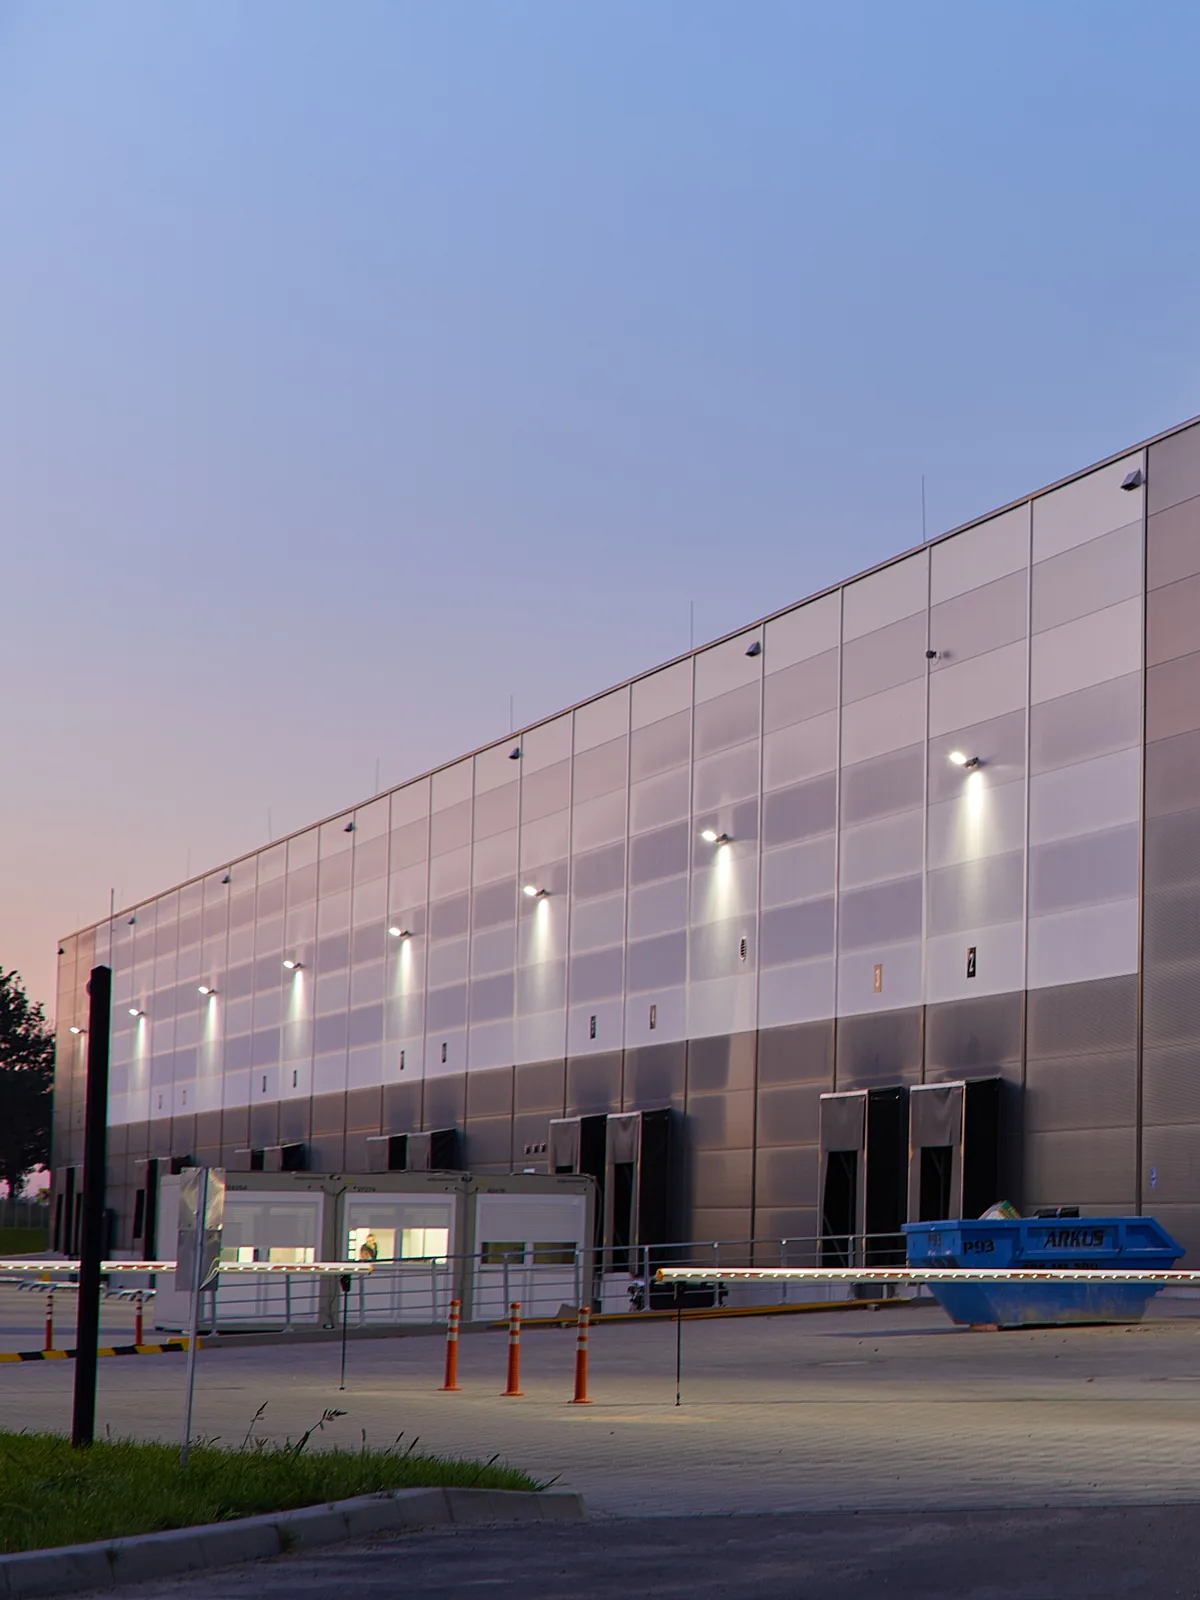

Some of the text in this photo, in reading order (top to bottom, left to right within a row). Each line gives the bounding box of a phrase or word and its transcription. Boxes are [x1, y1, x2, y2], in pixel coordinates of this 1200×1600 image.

[968, 953, 975, 973] 2
[963, 1239, 995, 1255] P93
[1044, 1229, 1105, 1248] ARKUS
